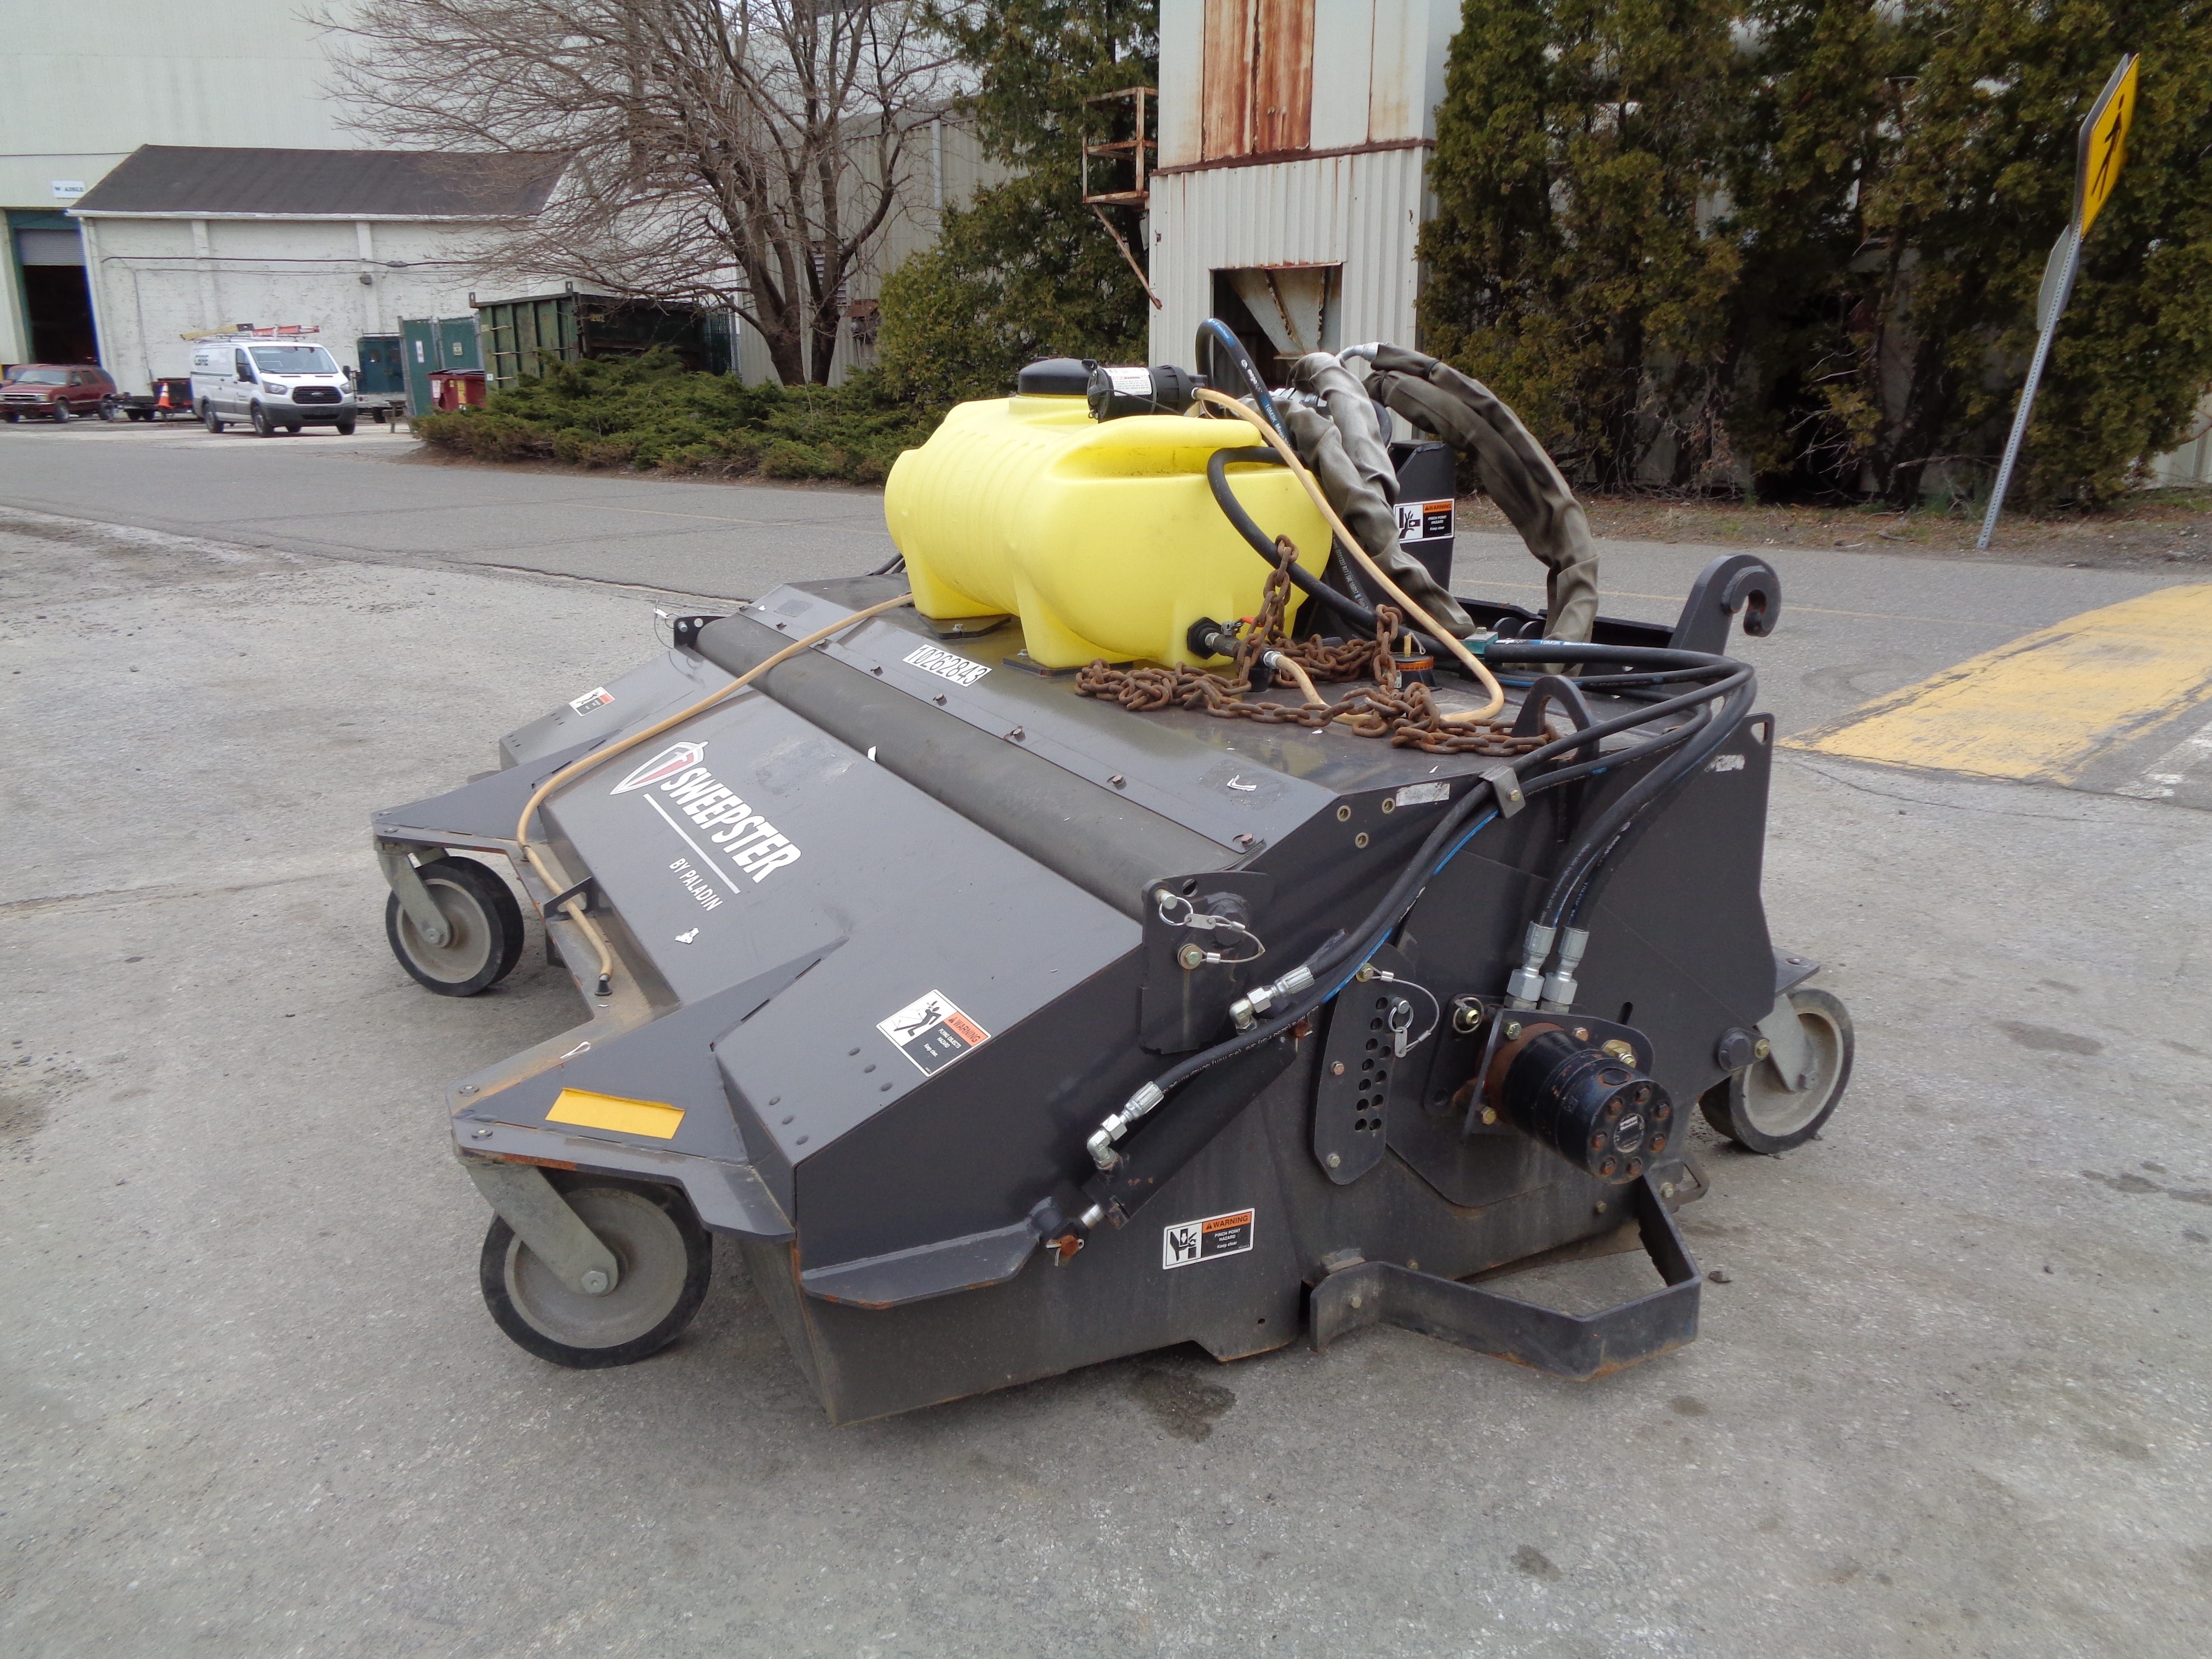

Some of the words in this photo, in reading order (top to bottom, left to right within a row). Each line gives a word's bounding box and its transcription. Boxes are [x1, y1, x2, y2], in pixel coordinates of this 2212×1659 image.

[1265, 404, 1277, 422] 10M3K
[907, 646, 988, 684] 10262843
[660, 767, 802, 884] SWEEPSTER
[669, 857, 691, 873] BY
[679, 869, 723, 912] PALADIN
[938, 1028, 950, 1039] FLYING
[947, 1036, 962, 1049] OBJECTS
[953, 1019, 981, 1042] WARNING
[936, 1036, 950, 1048] HAZARD
[1213, 1215, 1248, 1228] WARNING
